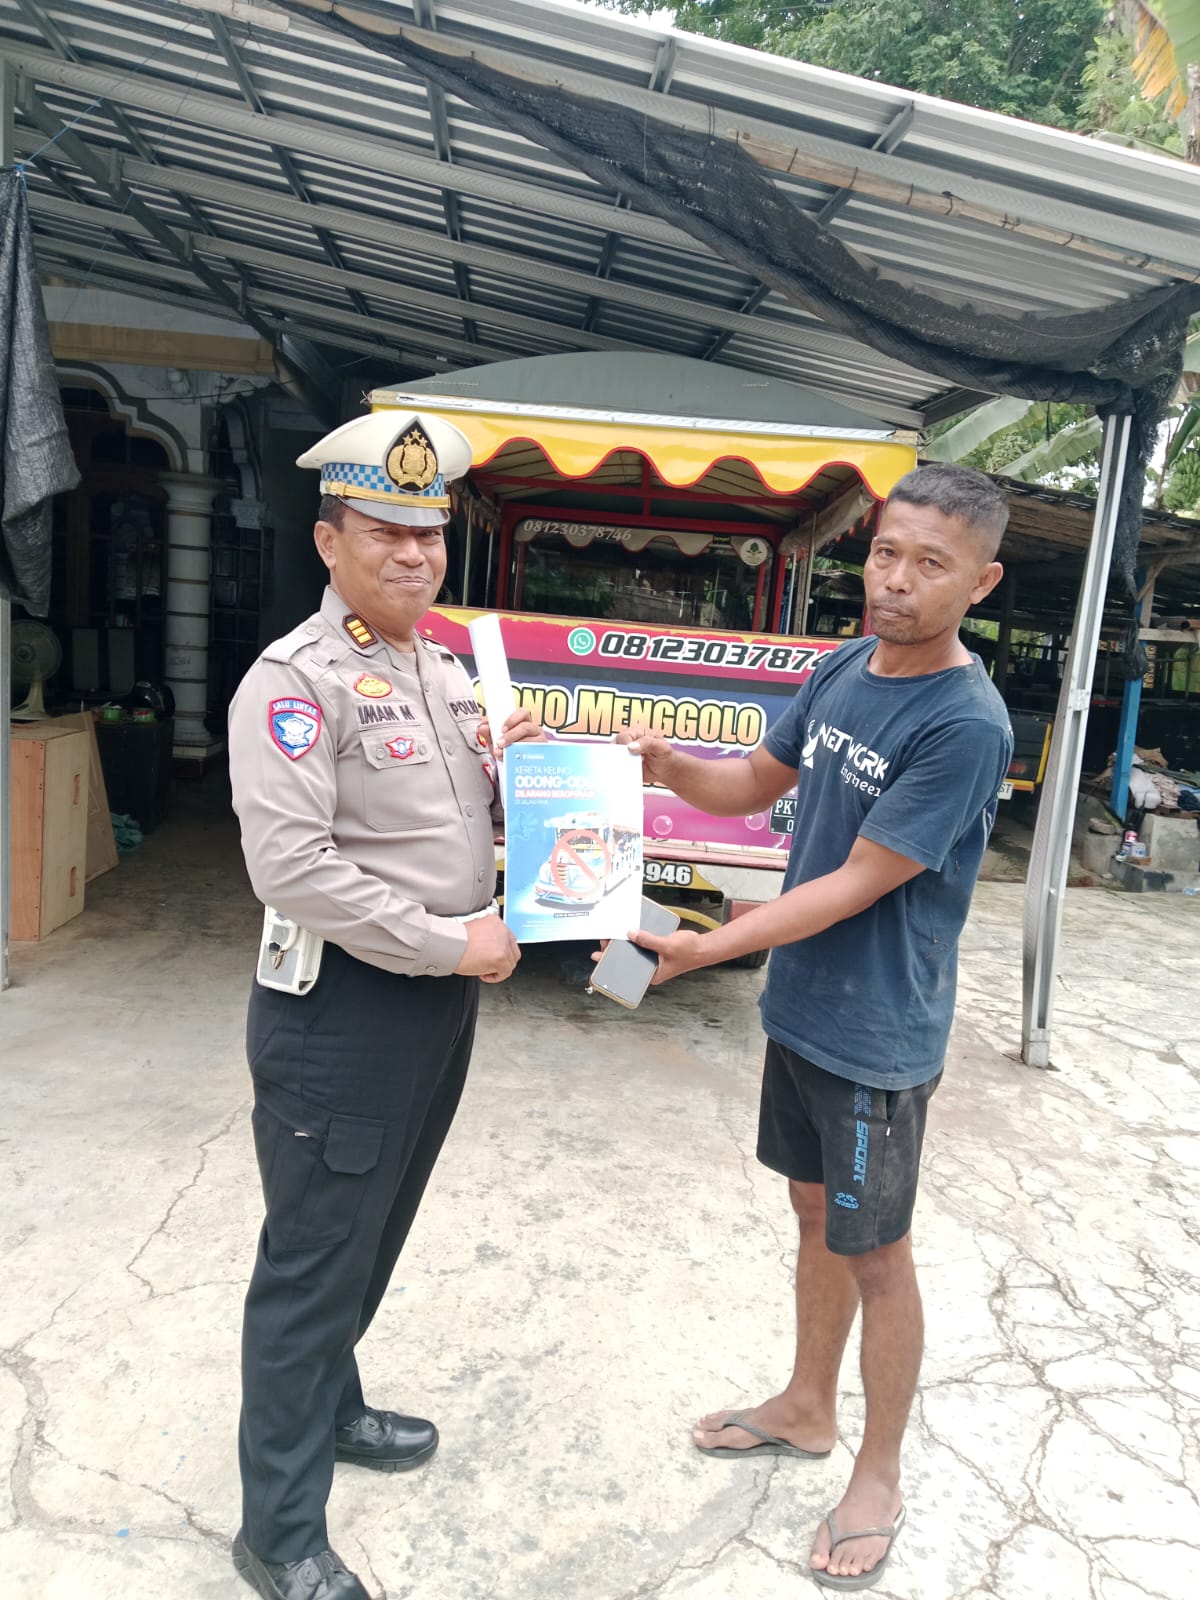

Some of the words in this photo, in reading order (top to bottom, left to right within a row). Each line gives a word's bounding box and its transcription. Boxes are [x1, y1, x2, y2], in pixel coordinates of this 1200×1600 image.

[523, 519, 632, 541] 081230378746
[358, 704, 400, 725] IMAM
[400, 704, 416, 721] M
[556, 689, 762, 746] MENGGOLO
[774, 799, 798, 815] PK
[853, 1119, 869, 1187] SPORT
